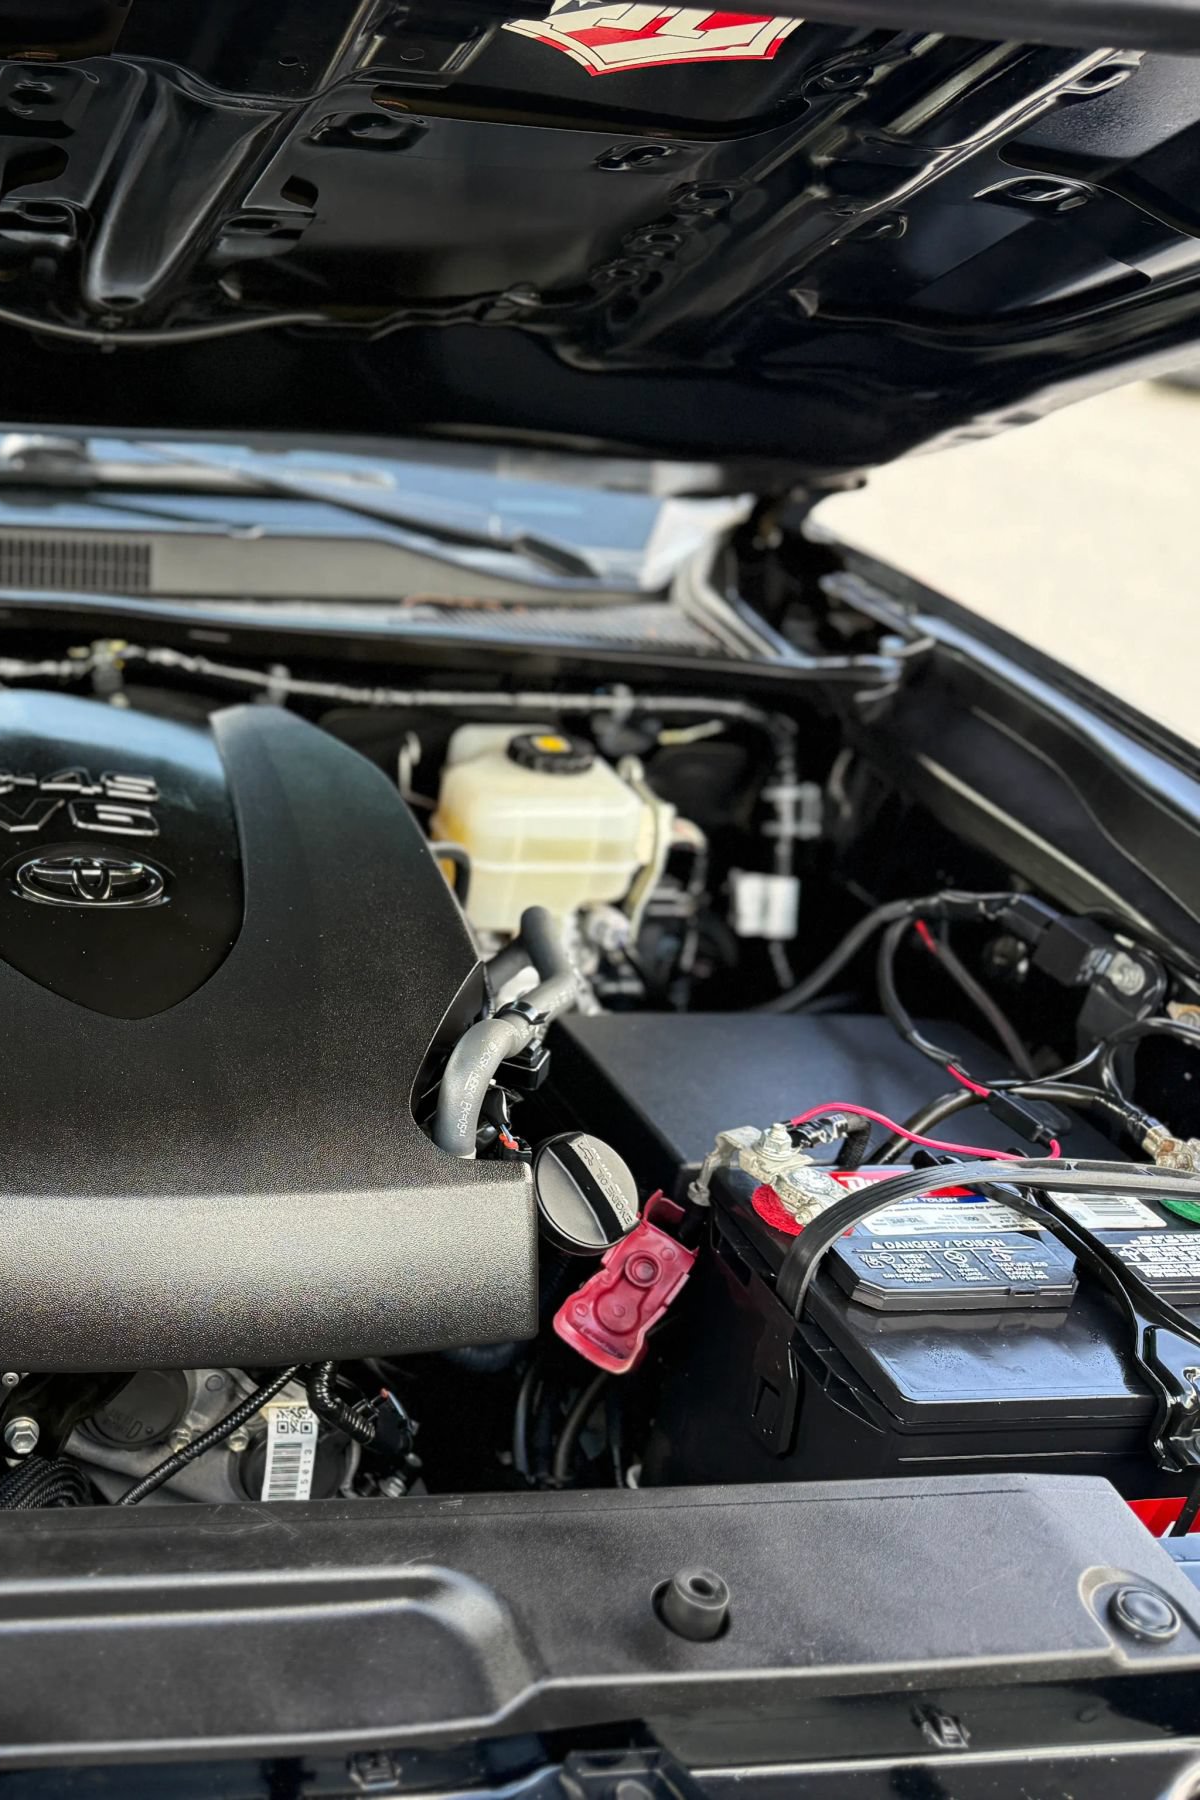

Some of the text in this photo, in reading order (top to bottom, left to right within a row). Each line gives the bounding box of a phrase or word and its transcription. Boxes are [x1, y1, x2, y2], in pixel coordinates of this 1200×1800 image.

[592, 1168, 609, 1187] OIL
[603, 1184, 634, 1225] ENGINE
[885, 1240, 940, 1249] DANGER
[956, 1238, 1006, 1248] POISON
